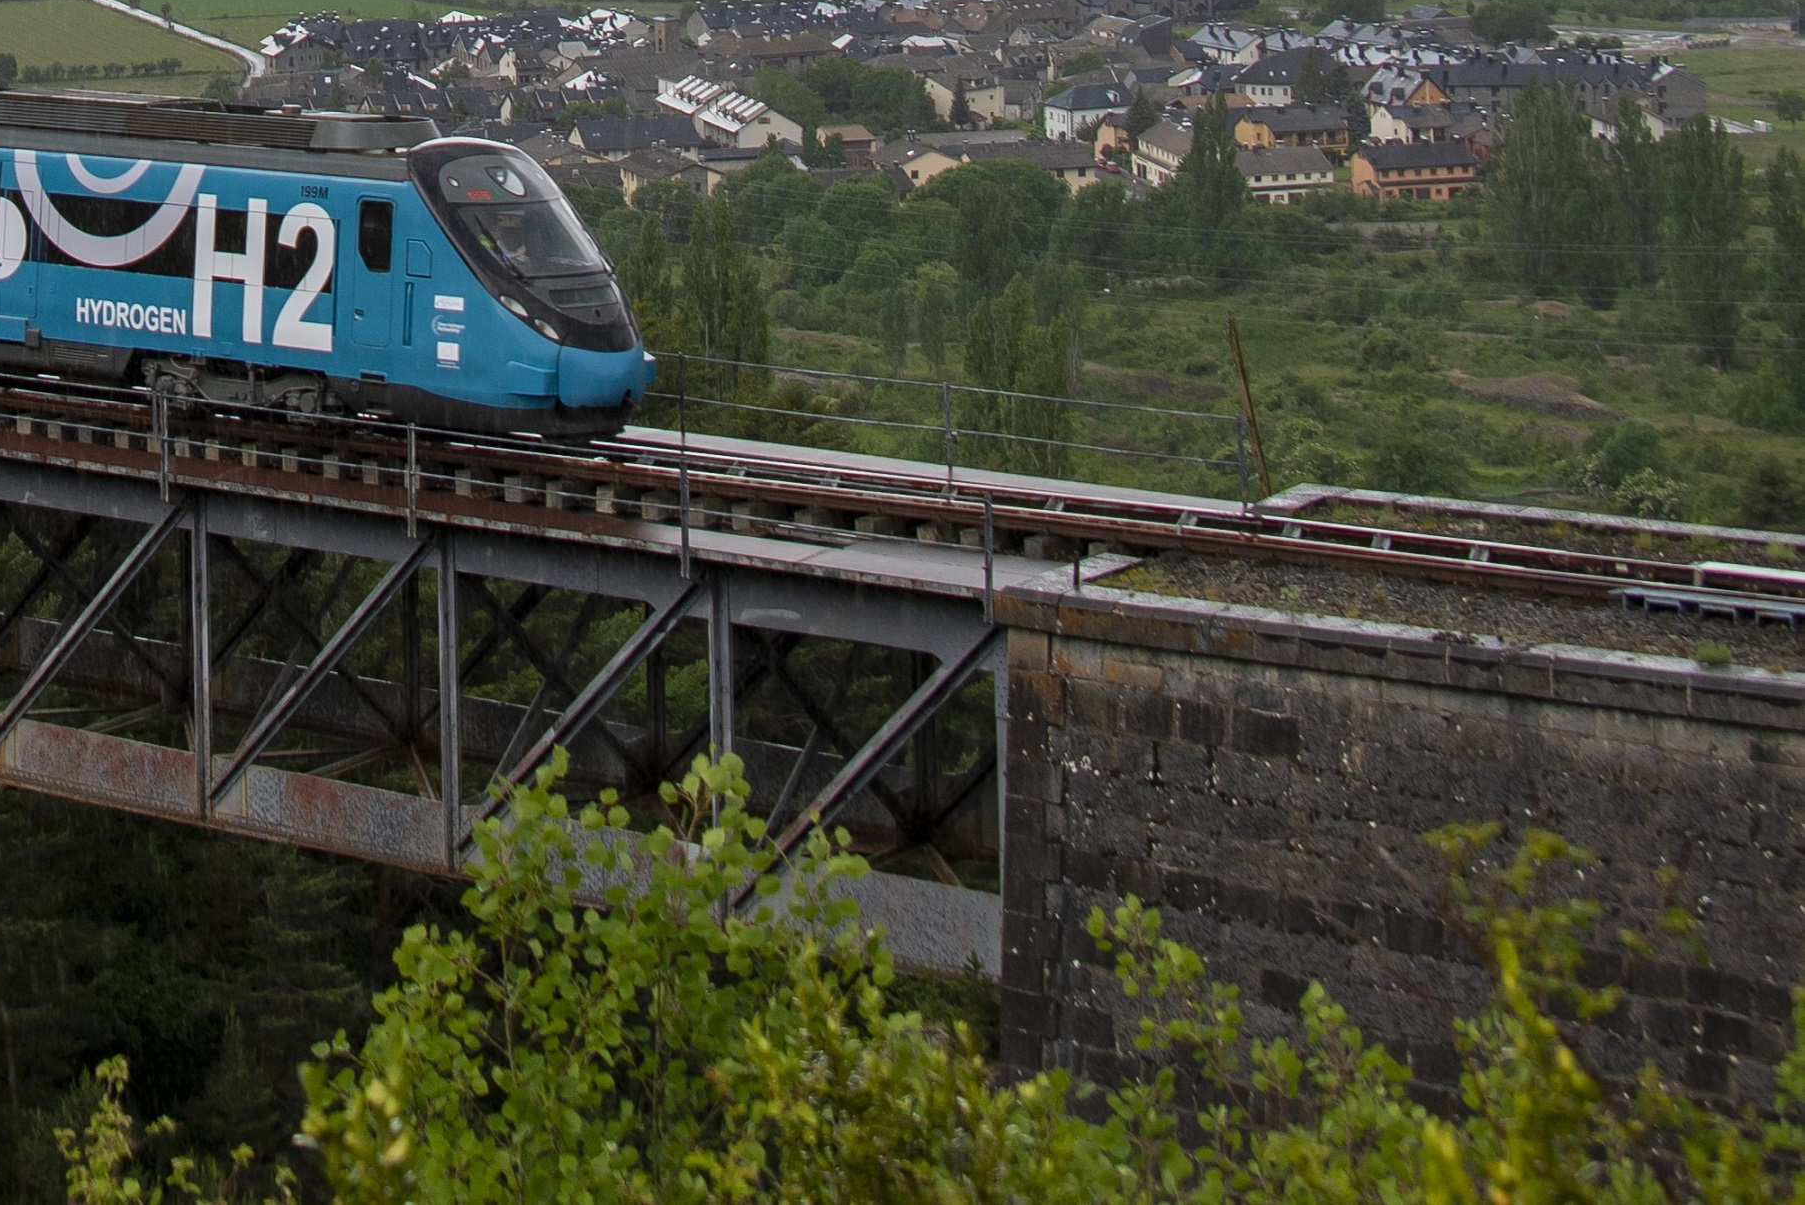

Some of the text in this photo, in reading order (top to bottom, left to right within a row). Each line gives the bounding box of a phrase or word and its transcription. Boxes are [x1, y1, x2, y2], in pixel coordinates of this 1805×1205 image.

[300, 185, 329, 199] 199M
[192, 192, 336, 352] H2
[75, 296, 187, 336] HYDROGEN
